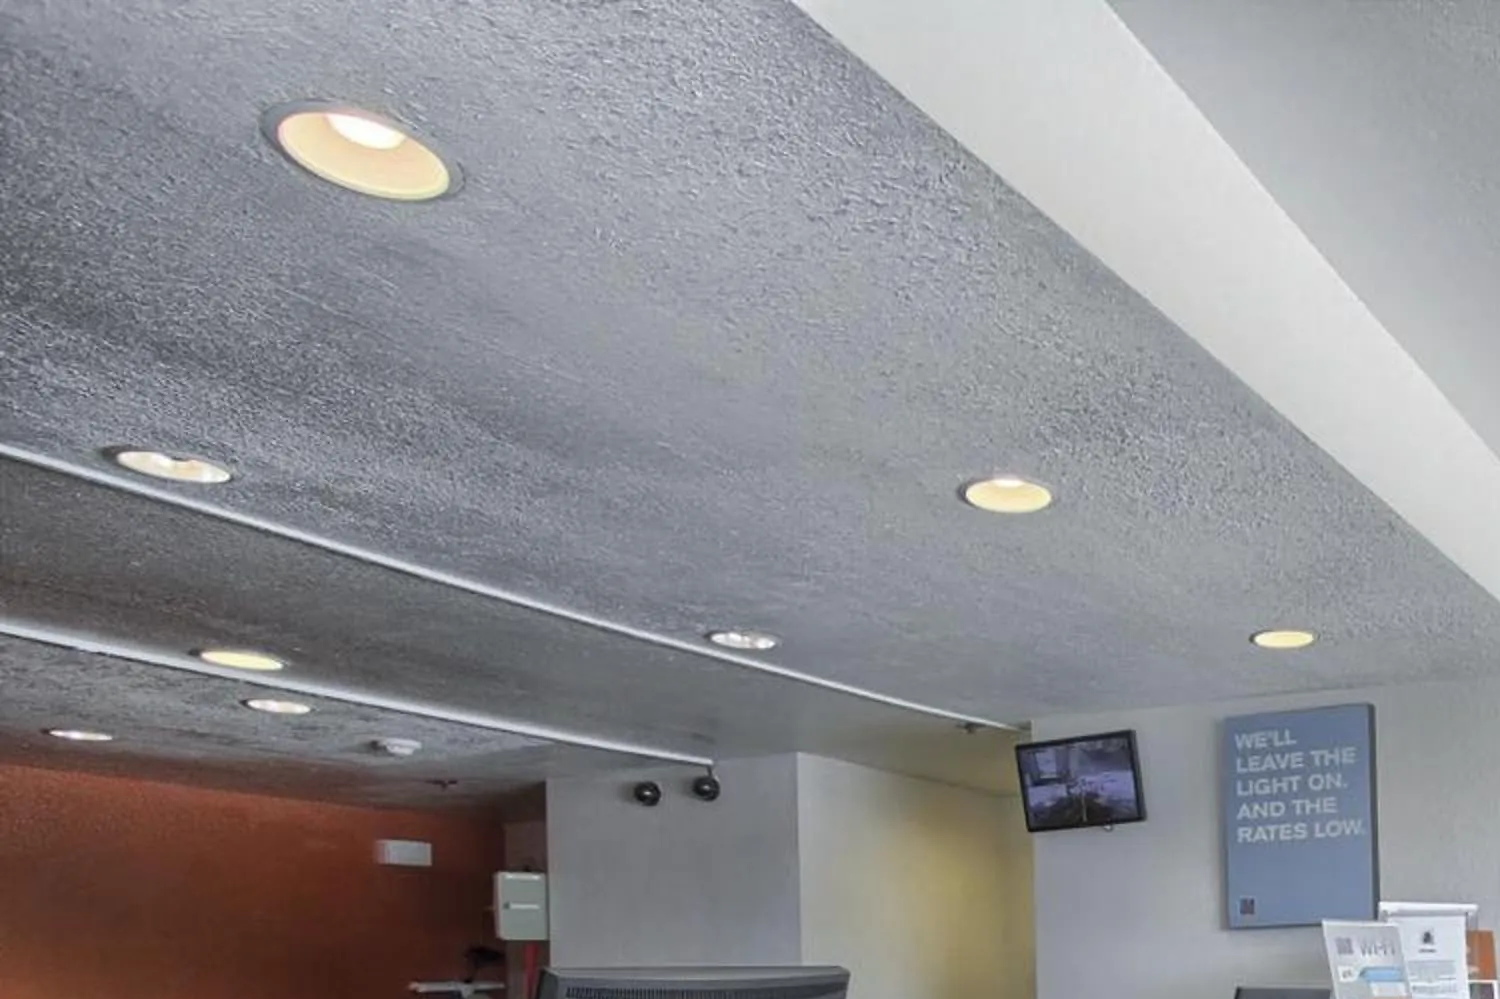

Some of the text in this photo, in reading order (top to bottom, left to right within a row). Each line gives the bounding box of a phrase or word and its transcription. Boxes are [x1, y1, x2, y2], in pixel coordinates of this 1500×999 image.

[1235, 728, 1297, 750] WE'LL
[1236, 747, 1357, 773] LEAVE THE
[1236, 773, 1348, 797] LIGHT ON.
[1236, 796, 1338, 821] AND THE
[1237, 819, 1366, 844] RATES LOW.
